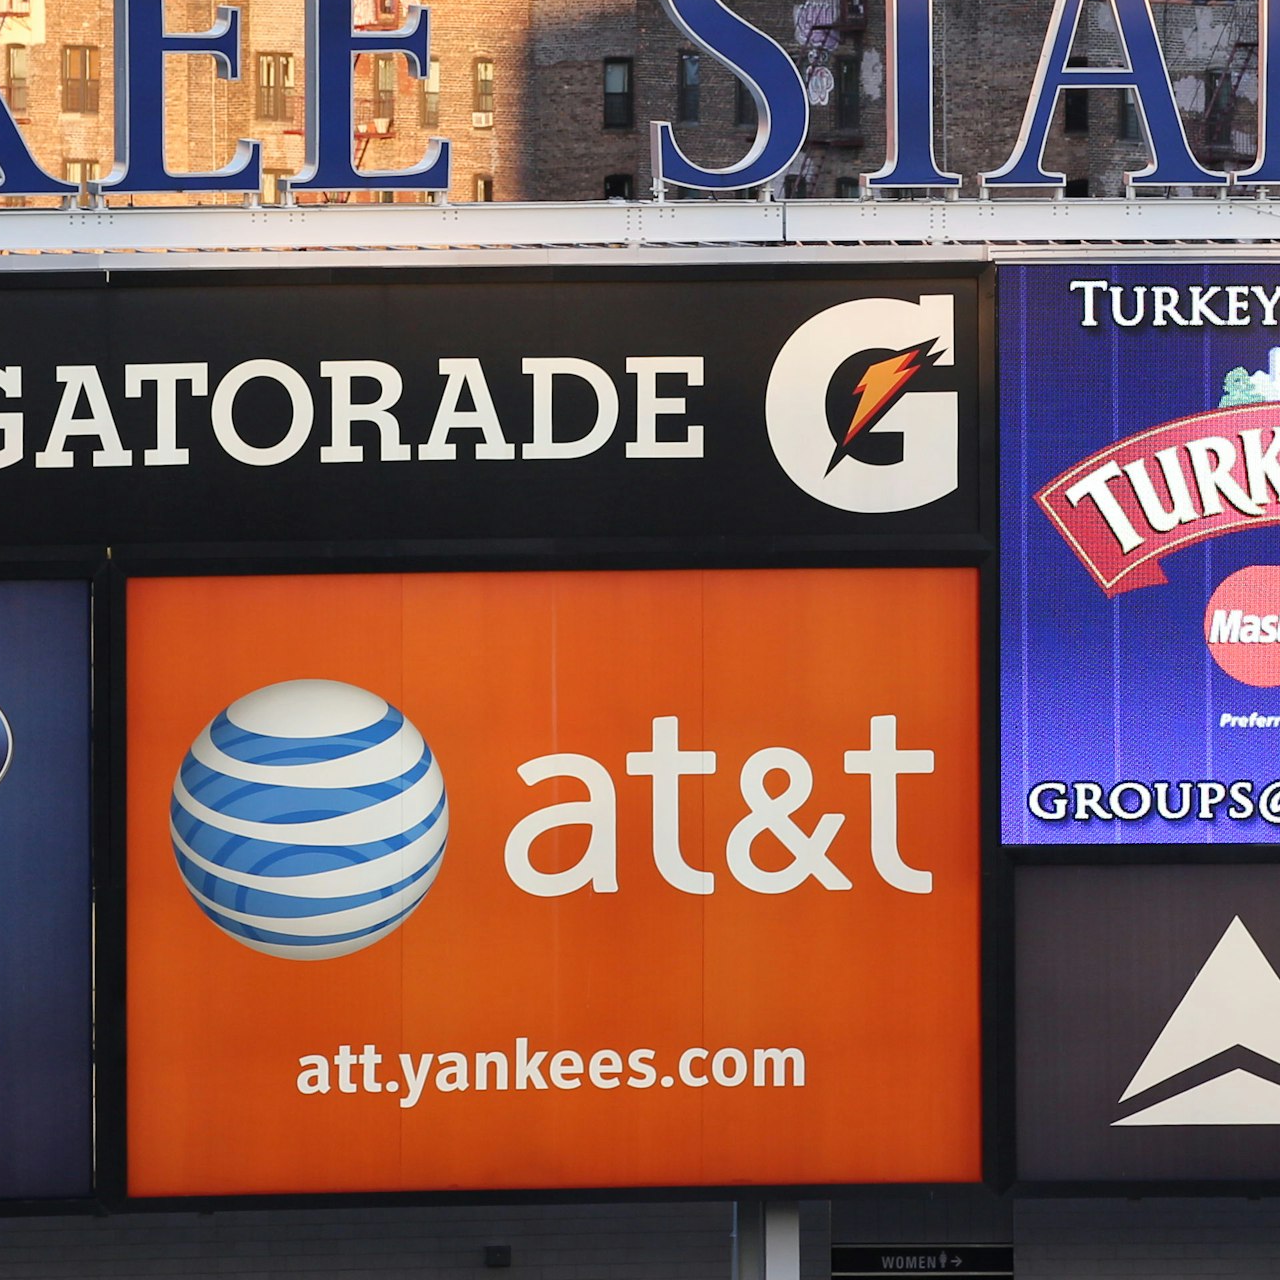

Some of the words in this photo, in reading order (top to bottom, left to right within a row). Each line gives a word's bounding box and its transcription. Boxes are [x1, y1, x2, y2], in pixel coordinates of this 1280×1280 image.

[765, 294, 958, 514] G
[504, 715, 935, 896] at&t
[296, 1038, 807, 1108] att.yankees.com
[881, 1255, 937, 1270] WOMEN
